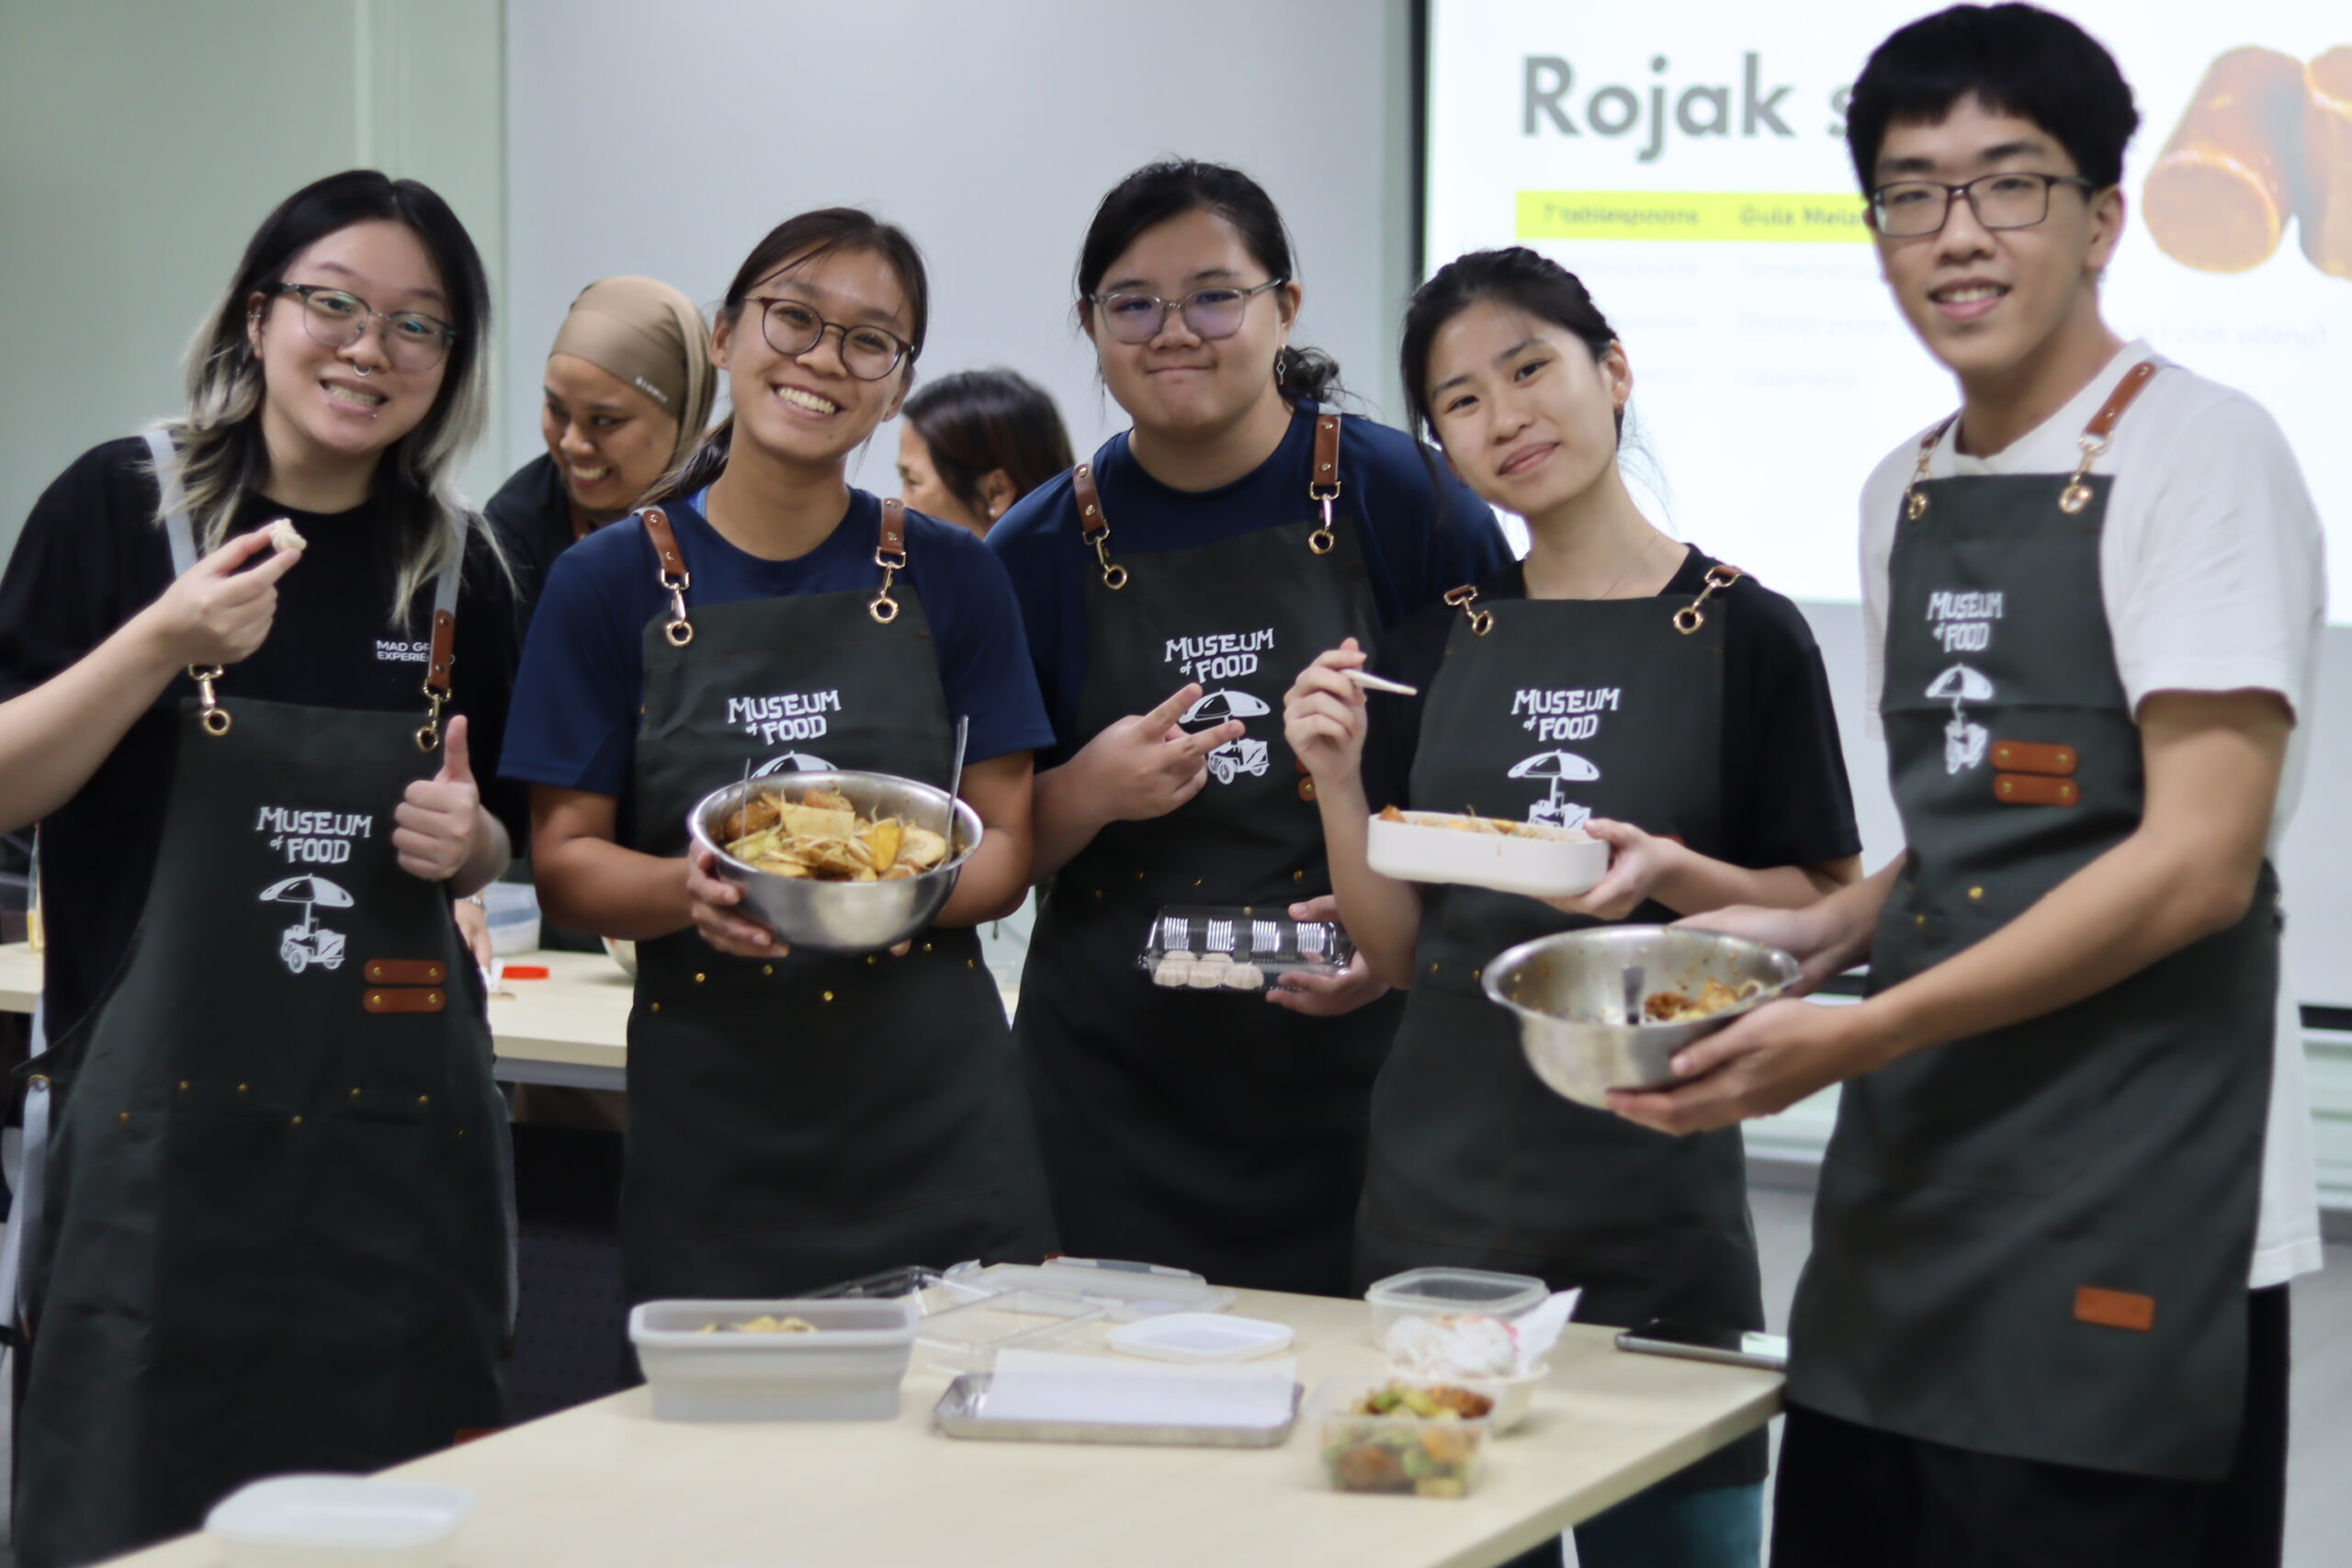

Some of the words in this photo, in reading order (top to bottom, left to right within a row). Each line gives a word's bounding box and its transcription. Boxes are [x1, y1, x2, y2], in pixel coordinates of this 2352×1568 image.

[1523, 51, 1795, 163] Rojak
[1926, 591, 2003, 621] MUSEUM
[376, 640, 409, 651] MAD
[1164, 627, 1275, 662] MUSEUM
[1943, 622, 1989, 653] FOOD
[1180, 660, 1193, 676] of
[1195, 653, 1258, 684] FOOD
[728, 690, 842, 724] MUSEUM
[1510, 688, 1621, 716] MUSEUM
[745, 722, 759, 736] of
[761, 715, 827, 746] FOOD
[1522, 716, 1537, 731] of
[1538, 714, 1599, 742] FOOD
[255, 807, 373, 838] MUSEUM
[270, 834, 284, 851] of
[287, 837, 351, 863] FOOD
